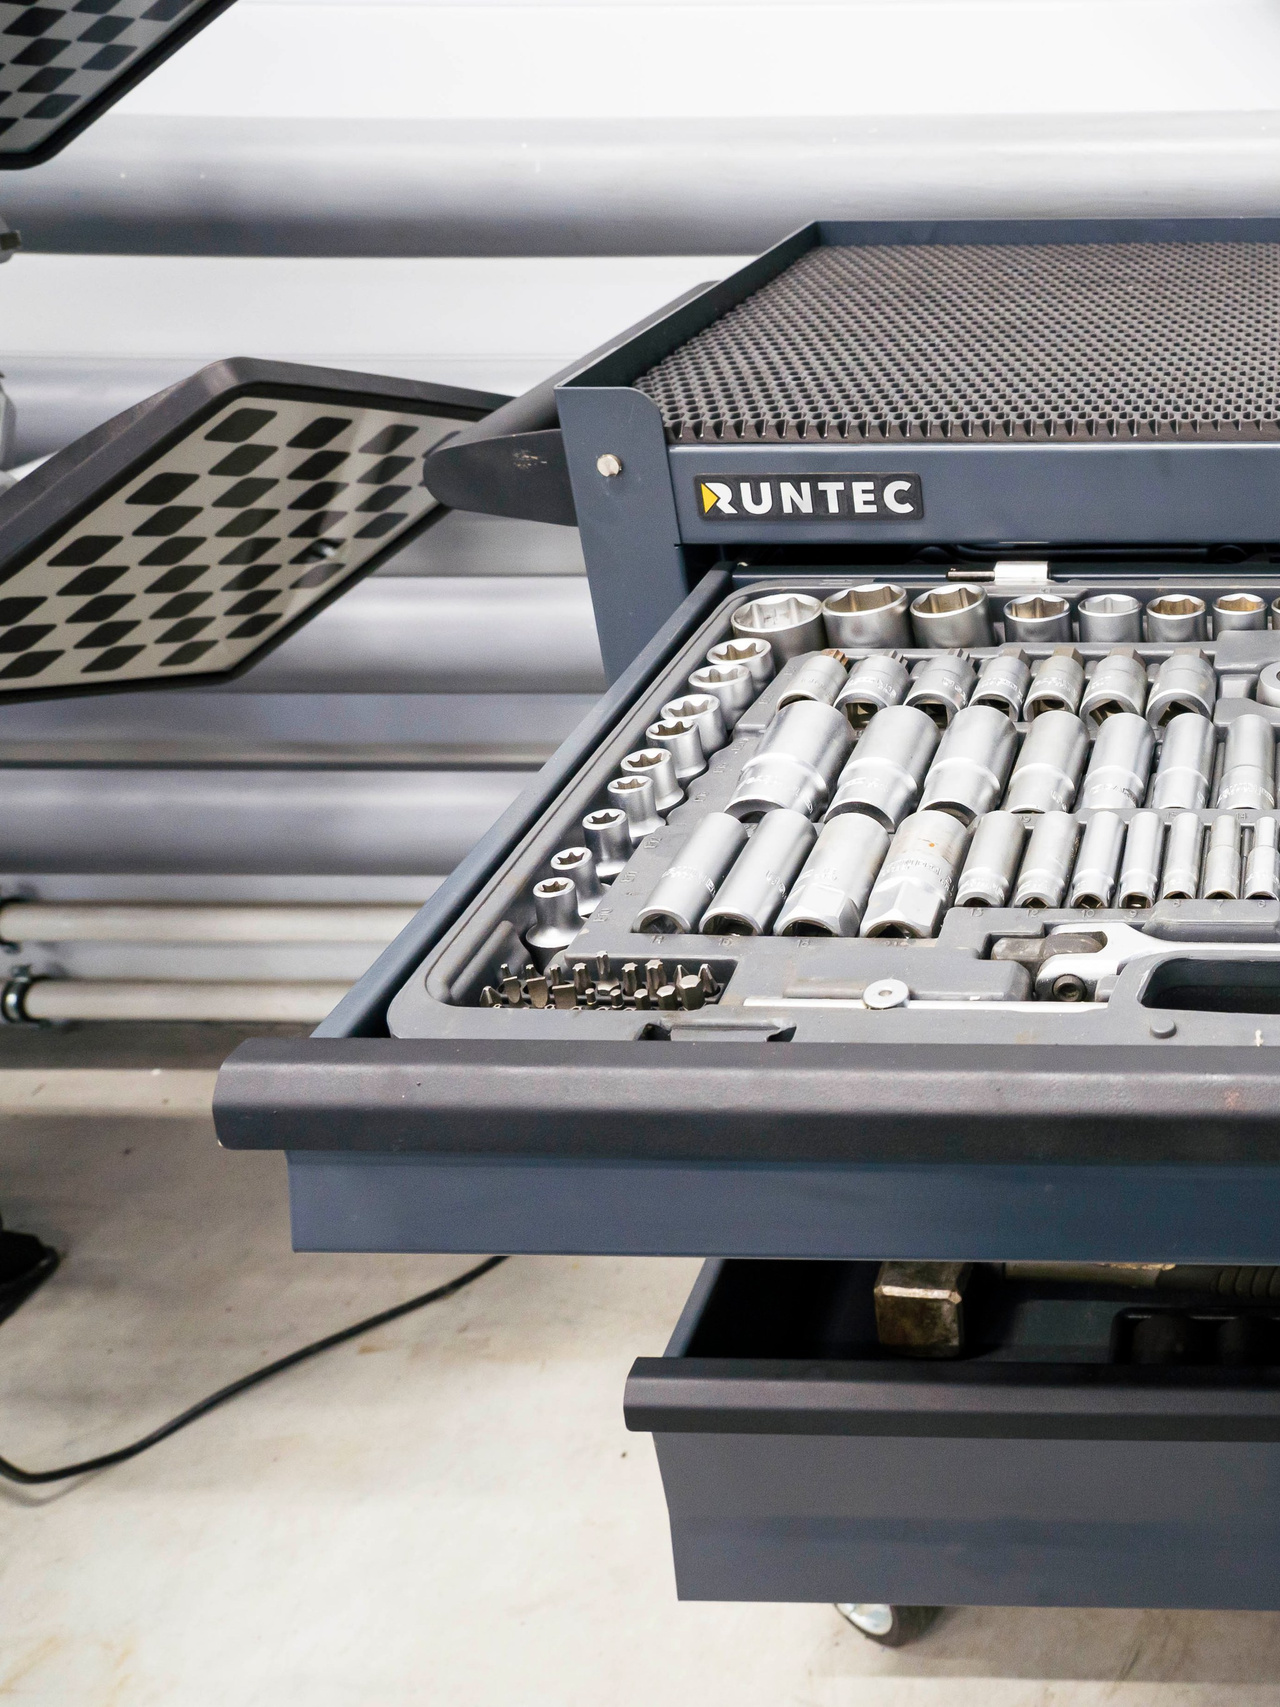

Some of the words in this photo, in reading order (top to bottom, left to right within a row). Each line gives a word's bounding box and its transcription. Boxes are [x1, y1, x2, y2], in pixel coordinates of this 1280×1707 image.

[701, 480, 915, 515] RUNTEC
[1081, 909, 1096, 918] 10
[1129, 909, 1138, 918] 9
